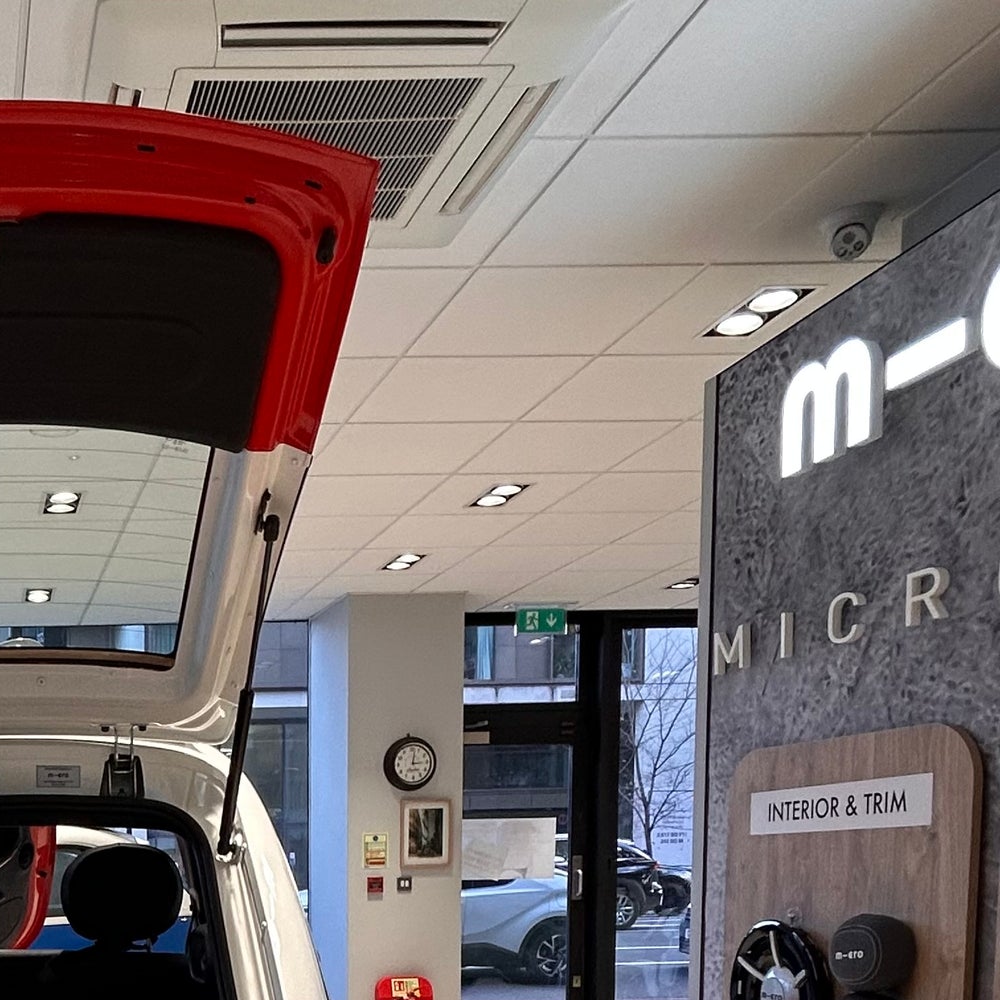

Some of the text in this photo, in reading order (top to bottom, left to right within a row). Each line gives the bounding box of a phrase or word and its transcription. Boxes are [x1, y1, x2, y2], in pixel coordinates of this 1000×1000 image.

[781, 257, 1000, 478] m-
[713, 566, 1000, 675] MICR
[768, 789, 907, 822] INTERIOR & TRIM
